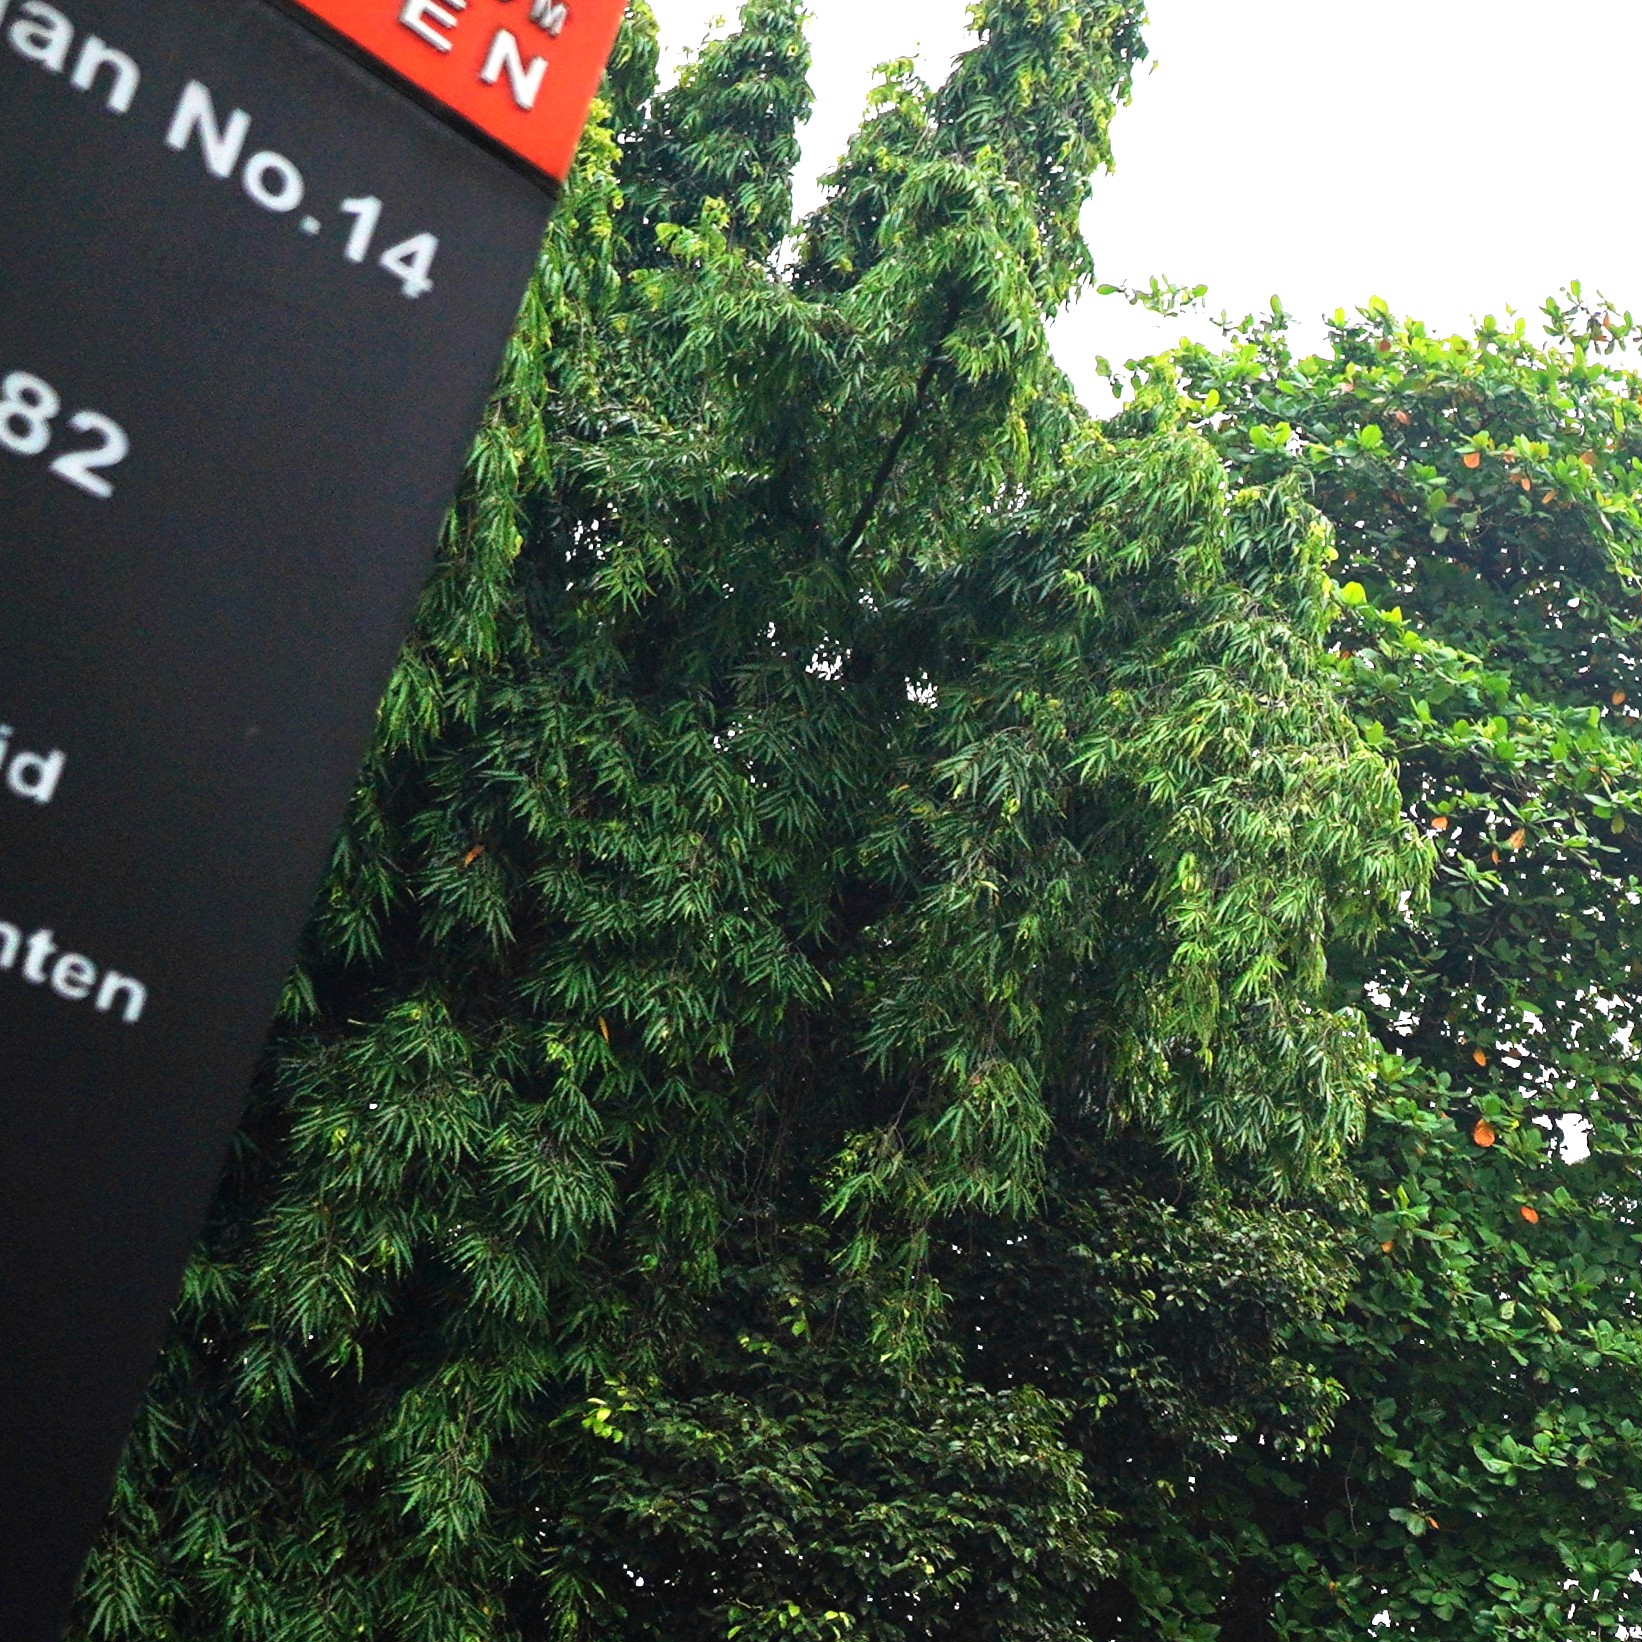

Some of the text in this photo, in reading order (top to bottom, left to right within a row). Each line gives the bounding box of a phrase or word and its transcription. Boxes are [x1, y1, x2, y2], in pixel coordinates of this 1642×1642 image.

[0, 0, 440, 300] an No.14
[0, 371, 130, 499] 82
